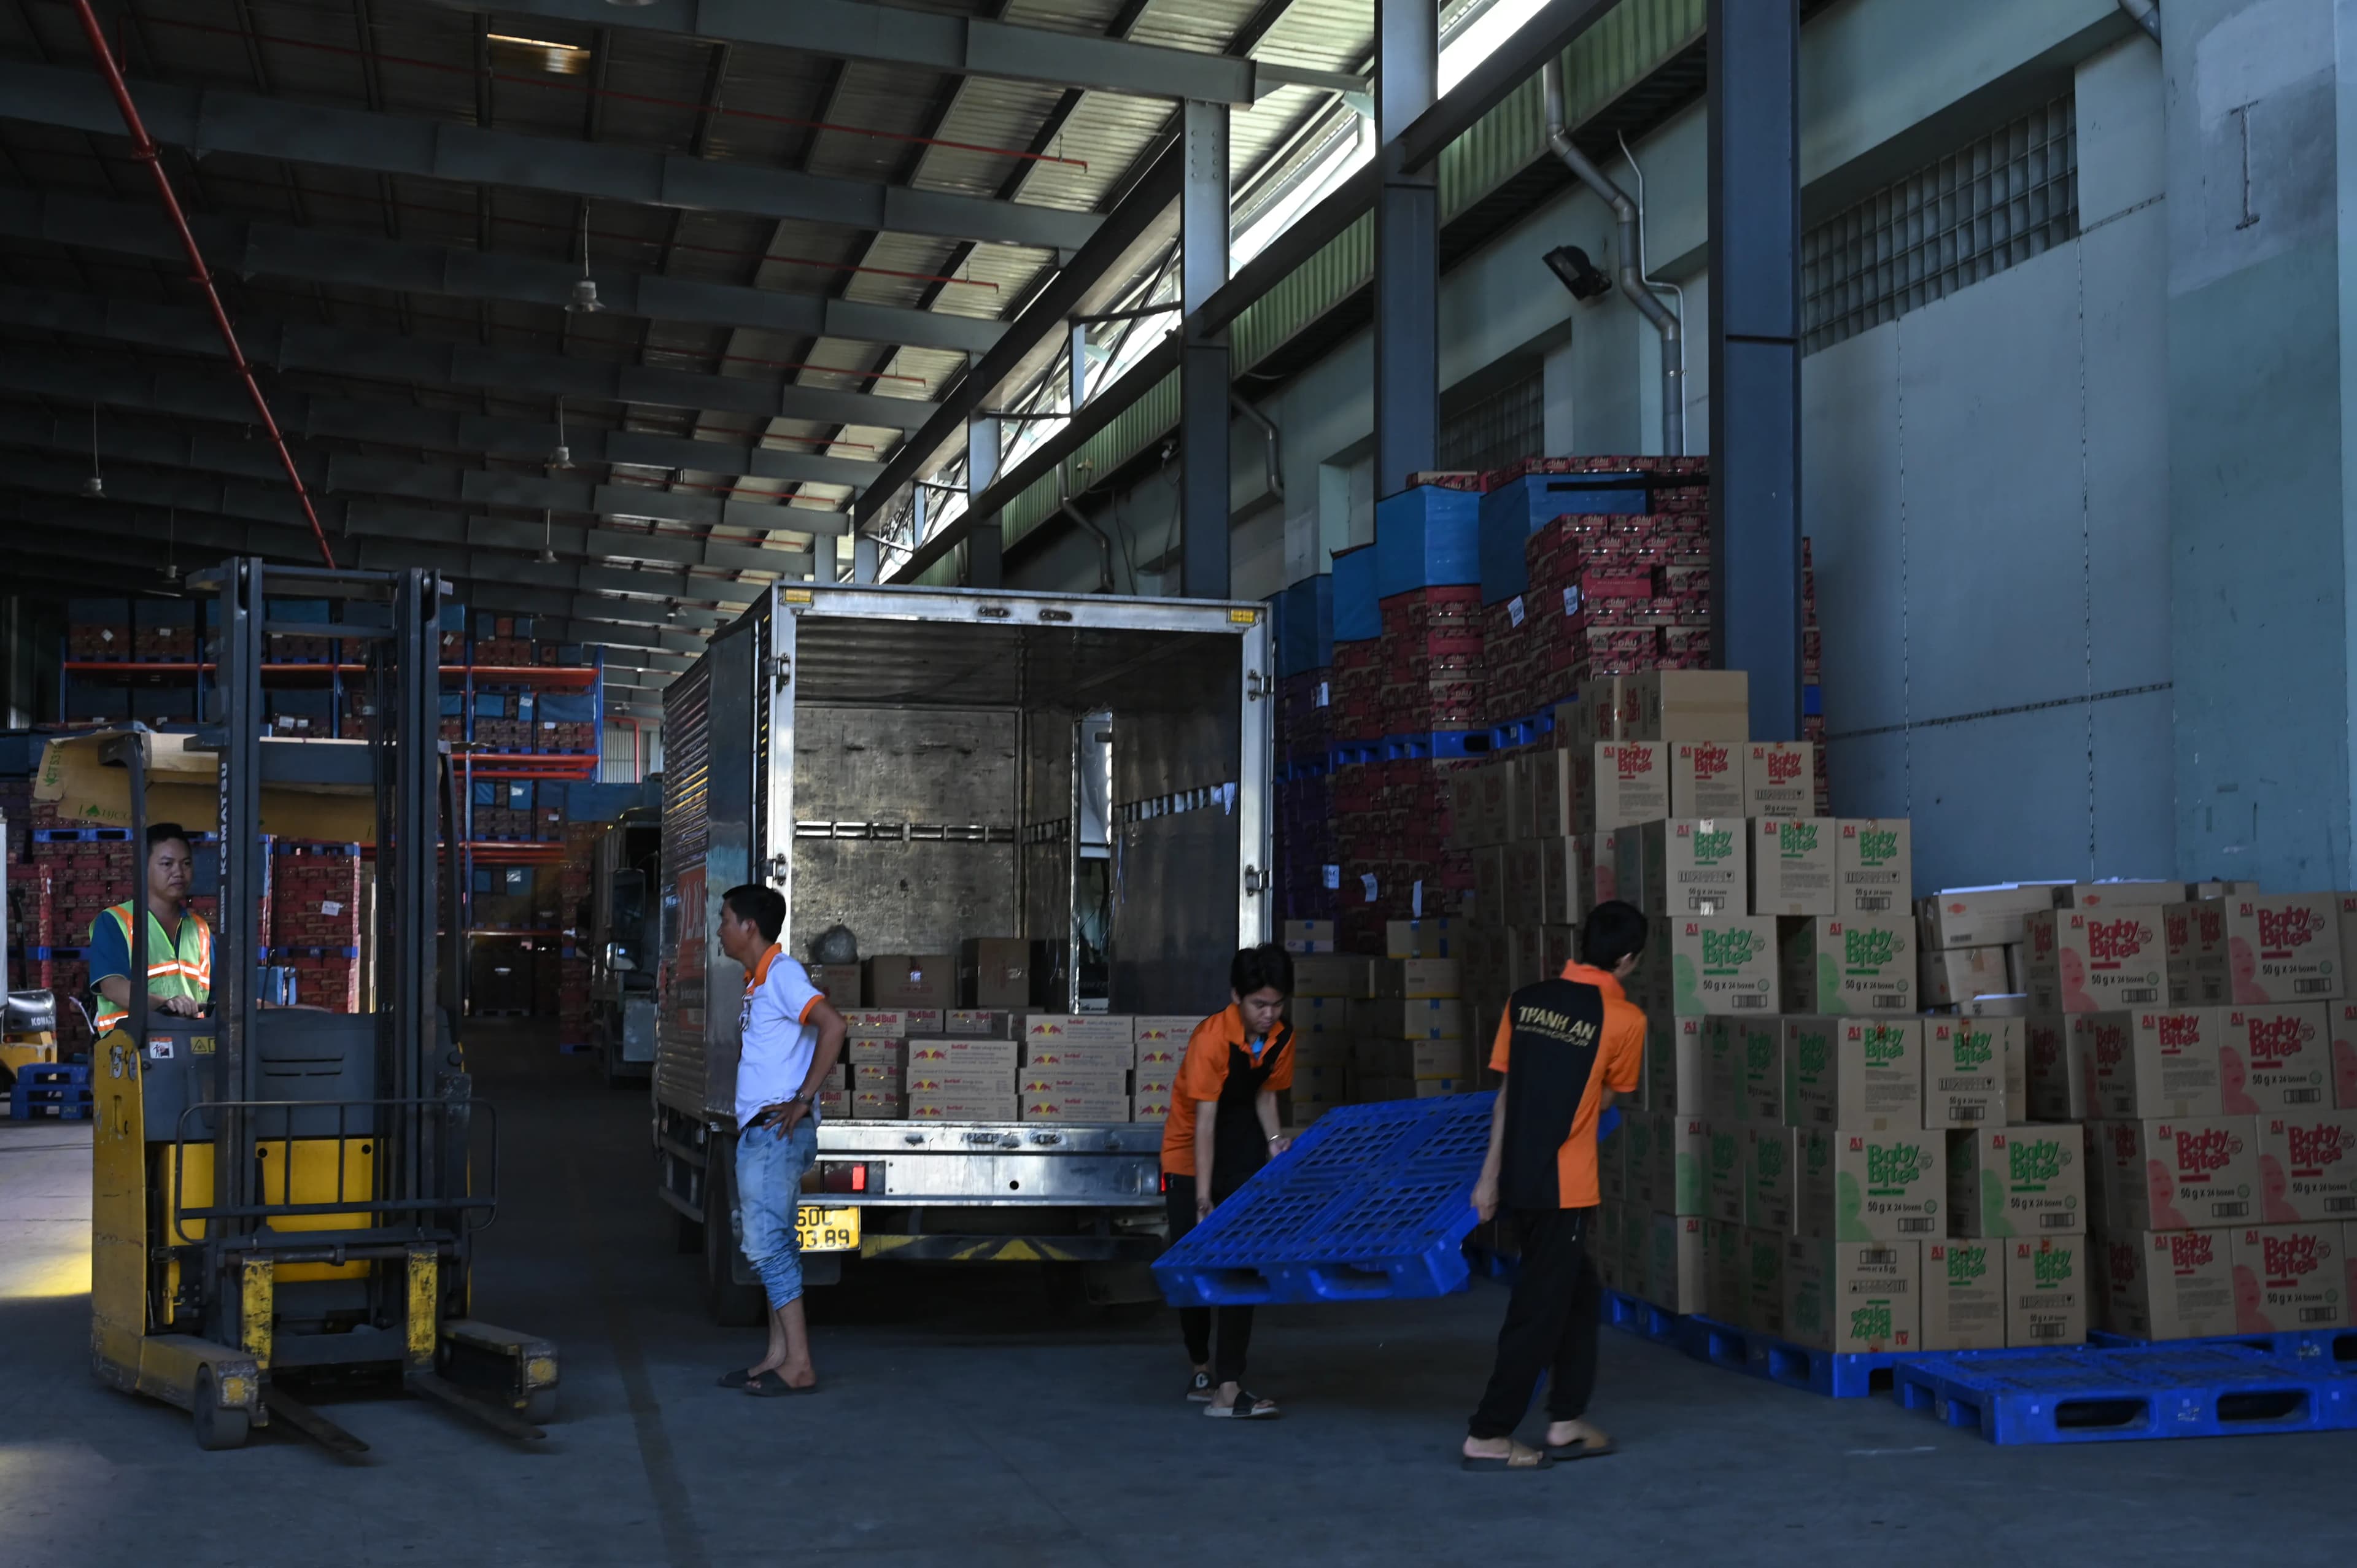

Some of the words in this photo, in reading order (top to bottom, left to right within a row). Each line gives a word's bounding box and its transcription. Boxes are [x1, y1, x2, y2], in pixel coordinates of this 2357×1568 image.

[1681, 747, 1690, 755] A1
[1754, 748, 1763, 757] A1
[1768, 751, 1802, 767] Baby
[1619, 760, 1652, 774] Bites
[1695, 760, 1728, 774] Bites
[1768, 764, 1802, 780] Bites
[1678, 825, 1689, 835] A1
[1765, 822, 1776, 832] A1
[1844, 827, 1855, 836] A1
[1781, 836, 1817, 852] Bites
[1860, 831, 1897, 847] Baby
[1695, 844, 1732, 860] Bites
[1860, 844, 1897, 861] Bites
[2240, 903, 2253, 914] A1
[2072, 916, 2083, 927] A1
[2258, 906, 2310, 930] Baby
[1686, 923, 1698, 933] A1
[1830, 923, 1841, 933] A1
[2088, 919, 2139, 942] Baby
[1702, 927, 1752, 949] Baby
[1845, 927, 1893, 950] Baby
[2259, 926, 2312, 949] Bites
[1846, 946, 1892, 967] Bites
[2089, 938, 2140, 960] Bites
[1703, 947, 1752, 967] Bites
[2263, 964, 2272, 975] 50
[1704, 979, 1713, 990] 50
[1846, 979, 1854, 989] 50
[2092, 975, 2100, 984] 50
[866, 1014, 880, 1022] Red
[1519, 1006, 1570, 1030] THANH
[1569, 1020, 1596, 1040] AN
[2143, 1016, 2154, 1026] A1
[2231, 1013, 2243, 1024] A1
[1848, 1027, 1860, 1038] A1
[1937, 1027, 1949, 1037] A1
[2248, 1015, 2301, 1040] Baby
[2161, 1029, 2199, 1048] Bites
[1865, 1043, 1904, 1061] Bites
[2250, 1035, 2302, 1059] Bites
[1955, 1046, 1992, 1065] Bites
[2253, 1075, 2262, 1085] 50
[2159, 1126, 2171, 1137] A1
[2272, 1121, 2283, 1131] A1
[1851, 1138, 1863, 1149] A1
[1994, 1136, 2005, 1146] A1
[2176, 1129, 2229, 1153] Baby
[2288, 1124, 2341, 1148] Baby
[1867, 1142, 1919, 1167] Baby
[2010, 1139, 2059, 1164] Baby
[2289, 1144, 2342, 1168] Bites
[2178, 1149, 2229, 1173] Bites
[1868, 1164, 1919, 1188] Bites
[2010, 1159, 2059, 1183] Bites
[2181, 1188, 2190, 1198] 50
[2293, 1182, 2302, 1193] 50
[1868, 1202, 1877, 1212] 50
[2011, 1198, 2019, 1208] 50
[2156, 1236, 2167, 1248] A1
[2246, 1231, 2258, 1242] A1
[1932, 1246, 1944, 1257] A1
[2018, 1245, 2029, 1254] A1
[2263, 1233, 2316, 1257] Baby
[2173, 1250, 2213, 1268] Bites
[2266, 1254, 2317, 1278] Bites
[1948, 1261, 1986, 1279] Bites
[2035, 1263, 2072, 1283] Bites
[2268, 1293, 2277, 1303] 50
[1851, 1307, 1891, 1324] Bites
